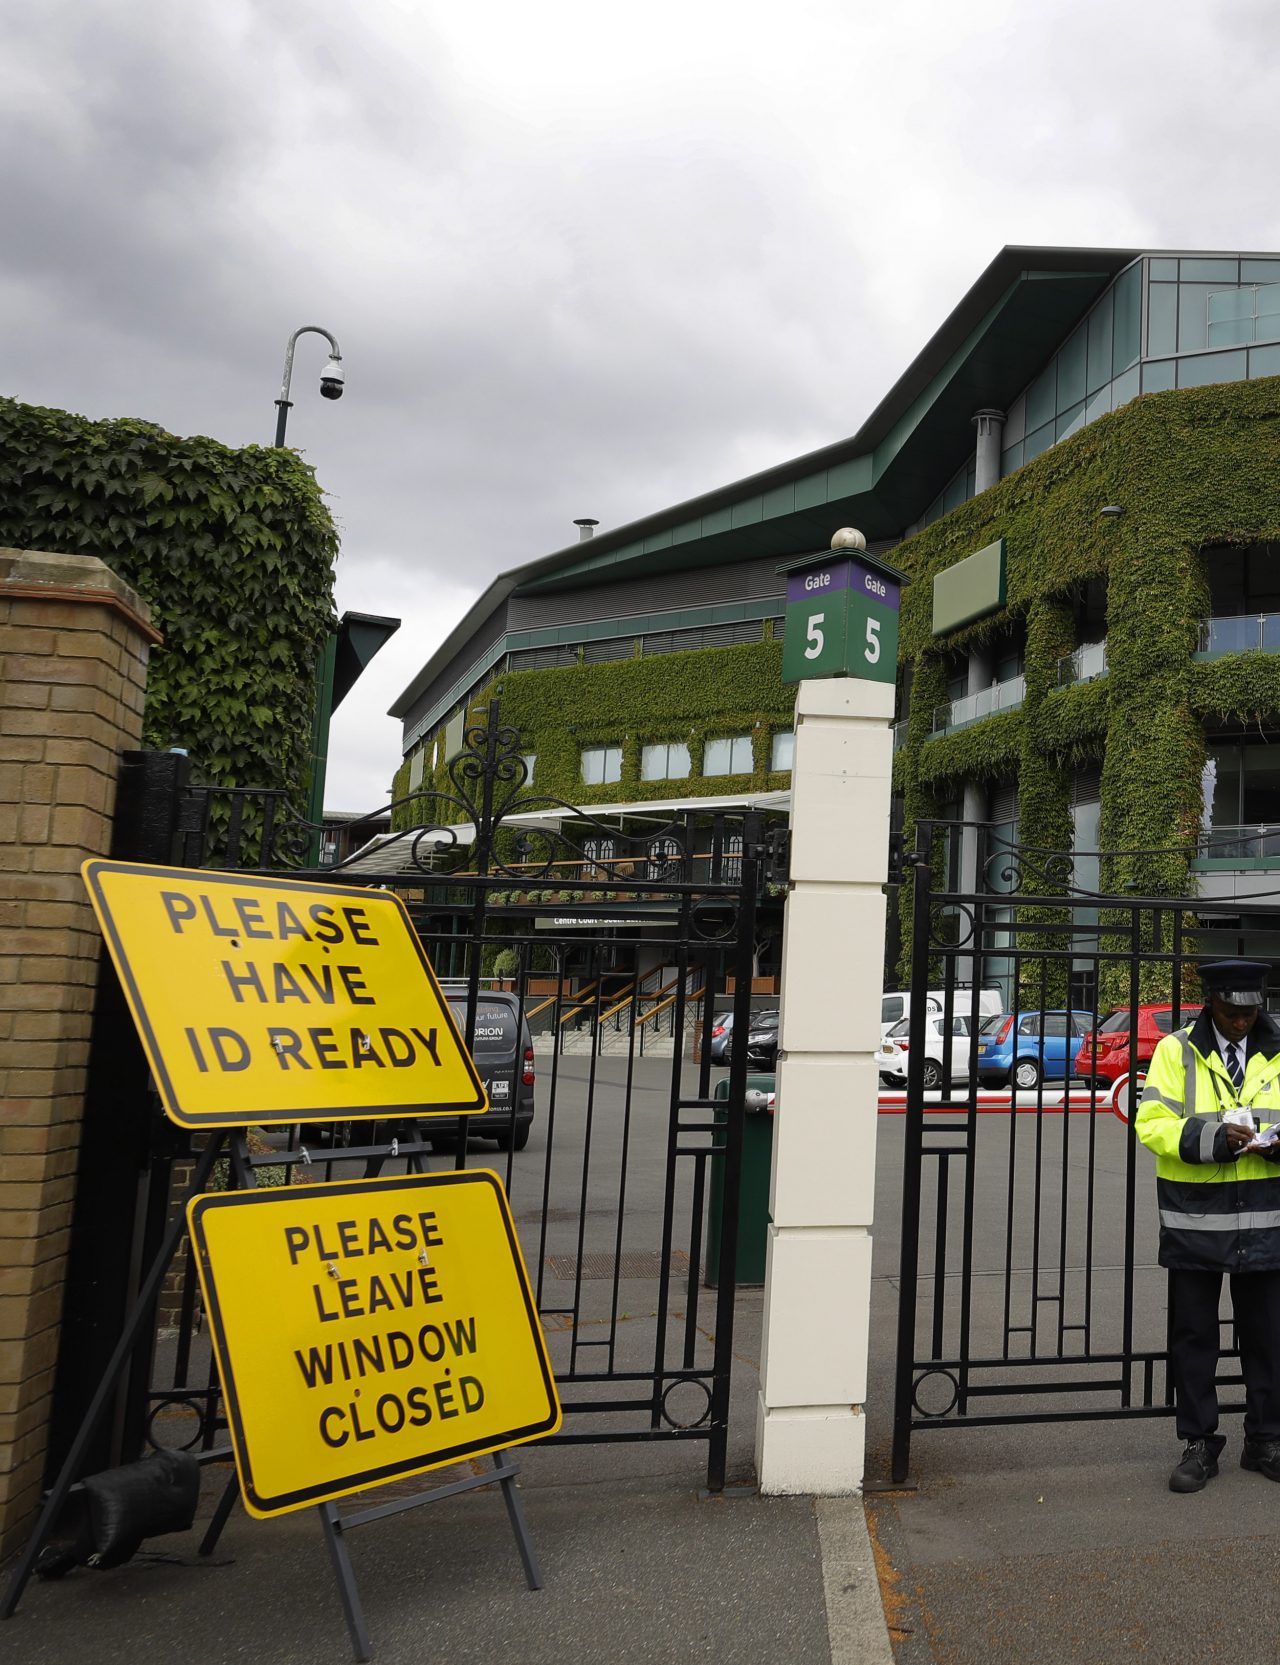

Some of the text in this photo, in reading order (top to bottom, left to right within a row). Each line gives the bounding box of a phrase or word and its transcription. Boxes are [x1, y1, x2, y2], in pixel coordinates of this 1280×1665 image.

[805, 573, 831, 590] Gate
[864, 574, 886, 597] Gate
[804, 613, 825, 660] 5
[864, 617, 881, 664] 5
[160, 891, 380, 946] PLEASE
[221, 960, 377, 1005] HAVE
[184, 1027, 443, 1073] ID READY
[284, 1211, 444, 1265] PLEASE
[313, 1267, 444, 1323] LEAVE
[294, 1317, 477, 1389] WINDOW
[319, 1375, 485, 1448] CLOSED
